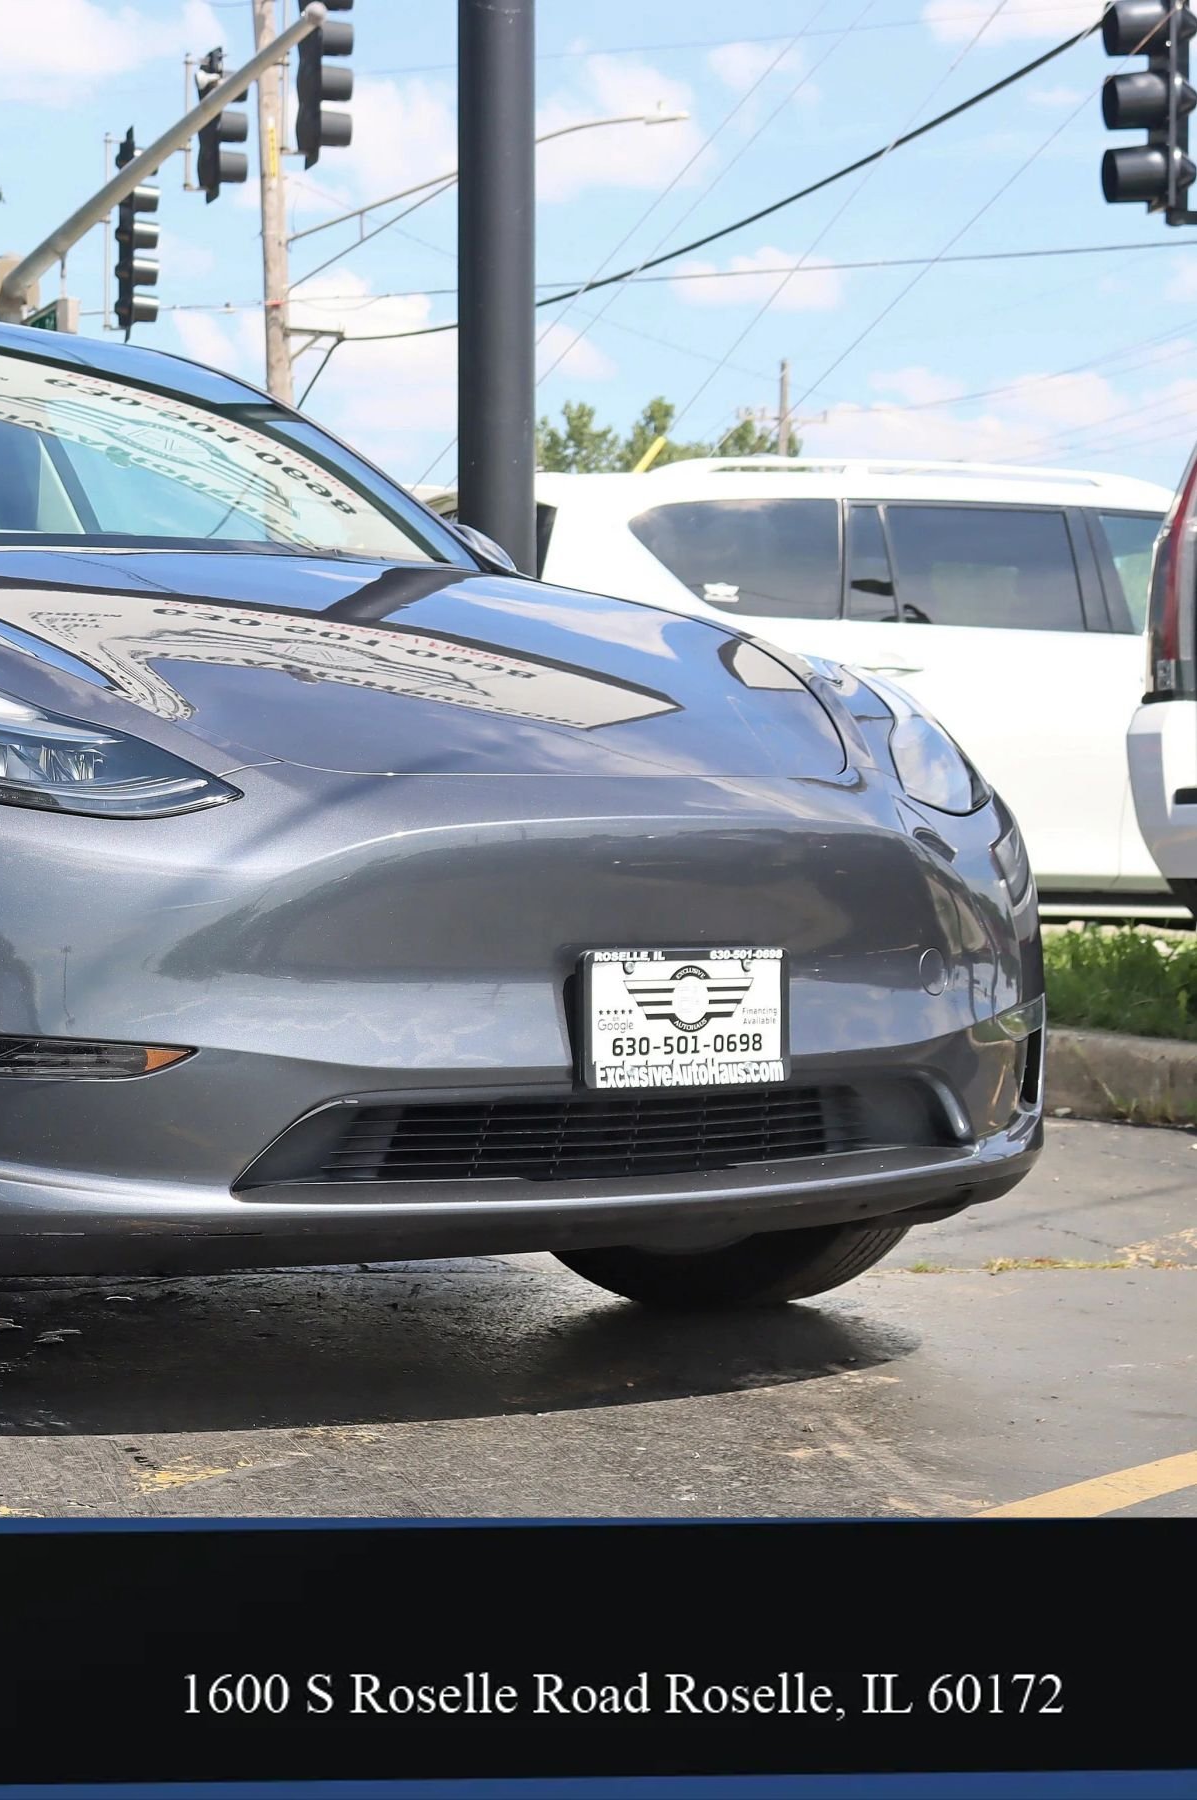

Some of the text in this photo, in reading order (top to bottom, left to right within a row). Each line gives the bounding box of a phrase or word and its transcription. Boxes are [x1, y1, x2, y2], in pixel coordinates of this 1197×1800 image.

[594, 951, 666, 962] ROSELLE, IL
[709, 949, 784, 960] 630-501-0698
[742, 1007, 778, 1017] Financing
[597, 1019, 634, 1033] Google
[673, 1018, 708, 1031] AUTOHAUS
[742, 1016, 777, 1025] Available
[612, 1033, 763, 1056] 630-501-0698
